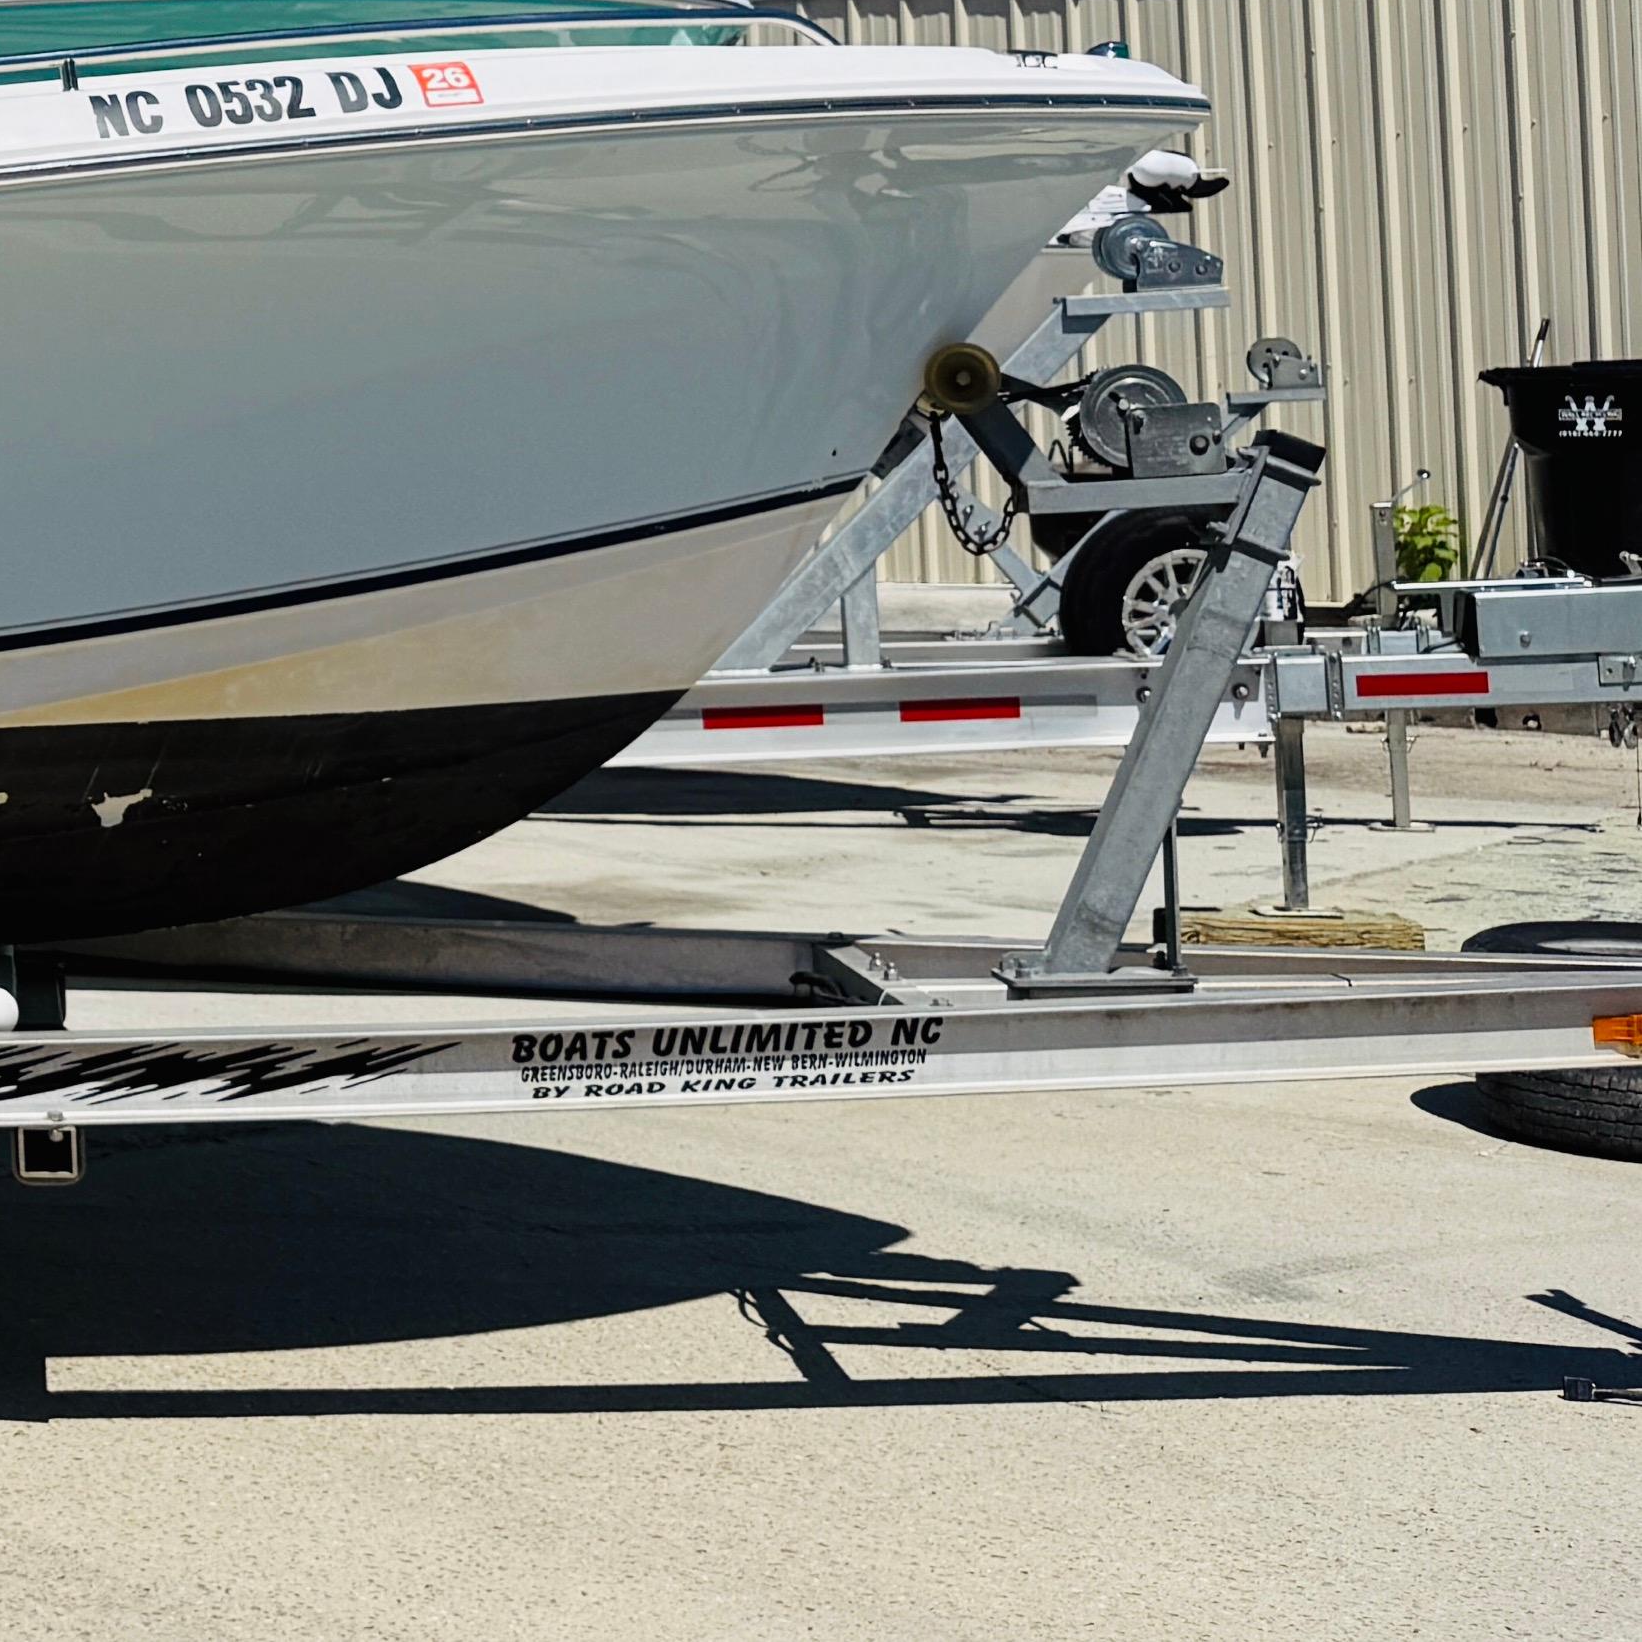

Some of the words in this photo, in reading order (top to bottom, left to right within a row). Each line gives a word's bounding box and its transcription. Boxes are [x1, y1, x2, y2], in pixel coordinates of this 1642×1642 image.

[422, 67, 470, 88] 26
[89, 90, 164, 138] NC
[185, 76, 316, 127] 0532
[326, 67, 403, 113] DJ
[512, 1029, 635, 1063] BOATS
[652, 1018, 872, 1057] UNLIMITED
[890, 1016, 943, 1046] NC
[532, 1085, 570, 1099] BY
[584, 1081, 666, 1098] ROAD
[681, 1077, 756, 1093] KING
[773, 1069, 914, 1088] TRAILERS
